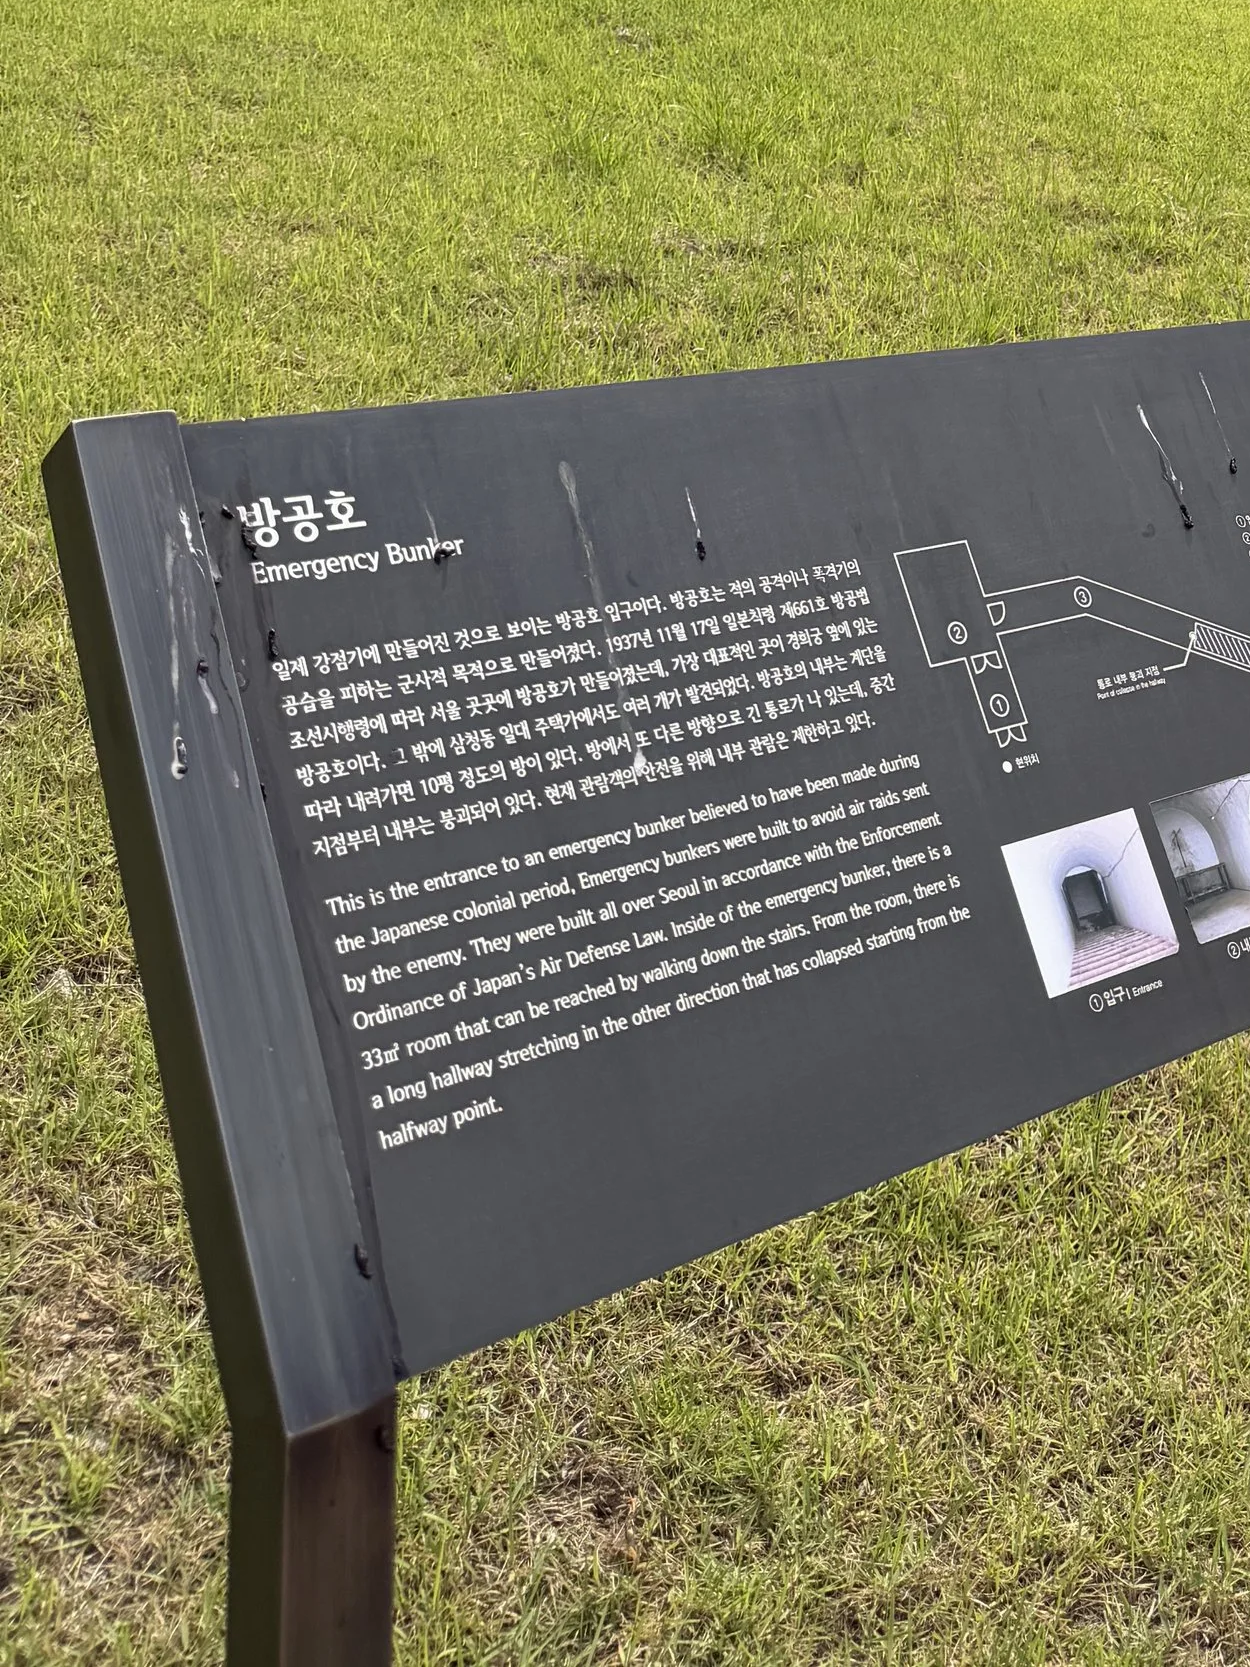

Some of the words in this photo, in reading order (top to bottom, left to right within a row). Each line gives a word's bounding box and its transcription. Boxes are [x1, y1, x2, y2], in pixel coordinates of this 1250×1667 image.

[236, 490, 368, 548] 방공호
[250, 550, 380, 584] Emergency
[385, 536, 465, 566] Bunker
[270, 654, 310, 682] 일제
[311, 642, 382, 675] 강점기에
[382, 630, 452, 662] 만들어진
[452, 624, 503, 650] 것으로
[505, 615, 553, 639] 보이는
[553, 605, 603, 632] 방공호
[603, 593, 668, 623] 입구이다.
[667, 584, 726, 610] 방공호는
[727, 576, 757, 599] 적의
[757, 566, 810, 594] 공격이나
[280, 687, 336, 717] 공습을
[337, 678, 393, 704] 피하는
[396, 665, 449, 695] 군사적
[451, 655, 518, 684] 목적으로
[517, 638, 602, 672] 만들어졌다.
[604, 627, 655, 654] 1937년
[655, 620, 688, 643] 11월
[688, 614, 722, 637] 17일
[721, 603, 777, 632] 일본칙령
[828, 585, 871, 610] 방공법
[288, 712, 389, 750] 조선시행령에
[388, 704, 425, 731] 따라
[429, 698, 462, 723] 서울
[464, 687, 514, 718] 곳곳에
[513, 675, 577, 707] 방공호가
[577, 657, 670, 693] 만들어졌는데,
[669, 650, 700, 674] 가장
[701, 639, 757, 667] 대표적인
[756, 632, 785, 657] 곳이
[784, 626, 824, 651] 경희궁
[824, 619, 853, 642] 옆에
[851, 615, 879, 637] 있는
[311, 823, 381, 858] 지점부터
[382, 814, 435, 841] 내부는
[438, 796, 502, 831] 붕괴되어
[502, 788, 543, 816] 있다.
[542, 778, 577, 806] 현재
[577, 763, 639, 798] 관람객의
[639, 755, 684, 783] 안전을
[685, 746, 717, 772] 위해
[715, 740, 746, 763] 내부
[746, 730, 790, 757] 관람은
[790, 717, 845, 745] 제한하고
[843, 709, 876, 734] 있다.
[1015, 752, 1040, 769] 현위치
[323, 892, 366, 916] This
[367, 887, 386, 906] is
[387, 880, 420, 901] the
[422, 861, 499, 892] entrance
[499, 855, 520, 873] to
[522, 850, 546, 867] an
[547, 827, 632, 860] emergency
[632, 813, 686, 839] bunker
[686, 793, 750, 824] believed
[749, 792, 768, 808] to
[766, 783, 804, 804] have
[802, 774, 840, 794] been
[839, 762, 877, 785] made
[878, 753, 921, 774] during
[333, 933, 366, 955] the
[369, 912, 449, 946] Japanese
[451, 889, 517, 923] colonial
[518, 875, 576, 909] period,
[576, 856, 660, 890] Emergency
[660, 840, 721, 867] bunkers
[721, 830, 758, 851] were
[756, 818, 792, 841] built
[790, 816, 809, 832] to
[809, 801, 847, 827] avoid
[847, 797, 866, 816] air
[867, 788, 901, 811] raids
[900, 780, 931, 802] sent
[341, 972, 367, 994] by
[369, 963, 402, 985] the
[405, 947, 467, 975] enemy.
[467, 933, 511, 957] They
[513, 922, 556, 945] were
[556, 907, 597, 933] built
[597, 899, 619, 922] all
[620, 893, 656, 915] over
[657, 877, 701, 905] Seoul
[700, 874, 719, 892] in
[720, 853, 802, 887] accordance
[802, 840, 834, 863] with
[834, 835, 860, 854] the
[858, 810, 943, 847] Enforcement
[351, 992, 445, 1030] Ordinance
[447, 979, 467, 1003] of
[538, 955, 563, 977] Air
[564, 938, 631, 969] Defense
[630, 928, 669, 949] Law.
[668, 911, 716, 938] Inside
[717, 903, 734, 924] of
[735, 899, 763, 918] the
[763, 877, 838, 910] emergency
[837, 862, 891, 887] bunker,
[890, 851, 927, 872] there
[925, 844, 941, 861] is
[404, 1030, 452, 1057] room
[453, 1015, 492, 1042] that
[492, 1008, 526, 1029] can
[525, 1000, 550, 1019] be
[551, 975, 617, 1012] reached
[616, 972, 638, 992] by
[639, 955, 698, 984] walking
[699, 943, 740, 966] down
[739, 934, 766, 954] the
[766, 922, 811, 946] stairs.
[810, 910, 849, 932] From
[847, 901, 873, 920] the
[872, 891, 913, 913] room,
[911, 879, 948, 900] there
[945, 872, 961, 889] is
[1132, 979, 1163, 996] Entrance
[370, 1093, 384, 1110] a
[385, 1079, 427, 1105] long
[428, 1057, 493, 1091] hallway
[496, 1031, 580, 1069] stretching
[579, 1023, 600, 1042] in
[599, 1015, 629, 1036] the
[630, 1001, 672, 1026] other
[674, 980, 740, 1012] direction
[740, 967, 773, 991] that
[770, 961, 800, 981] has
[800, 936, 865, 971] collapsed
[864, 923, 916, 951] starting
[915, 913, 949, 934] from
[947, 905, 971, 924] the
[377, 1114, 448, 1150] halfway
[450, 1094, 503, 1130] point.
